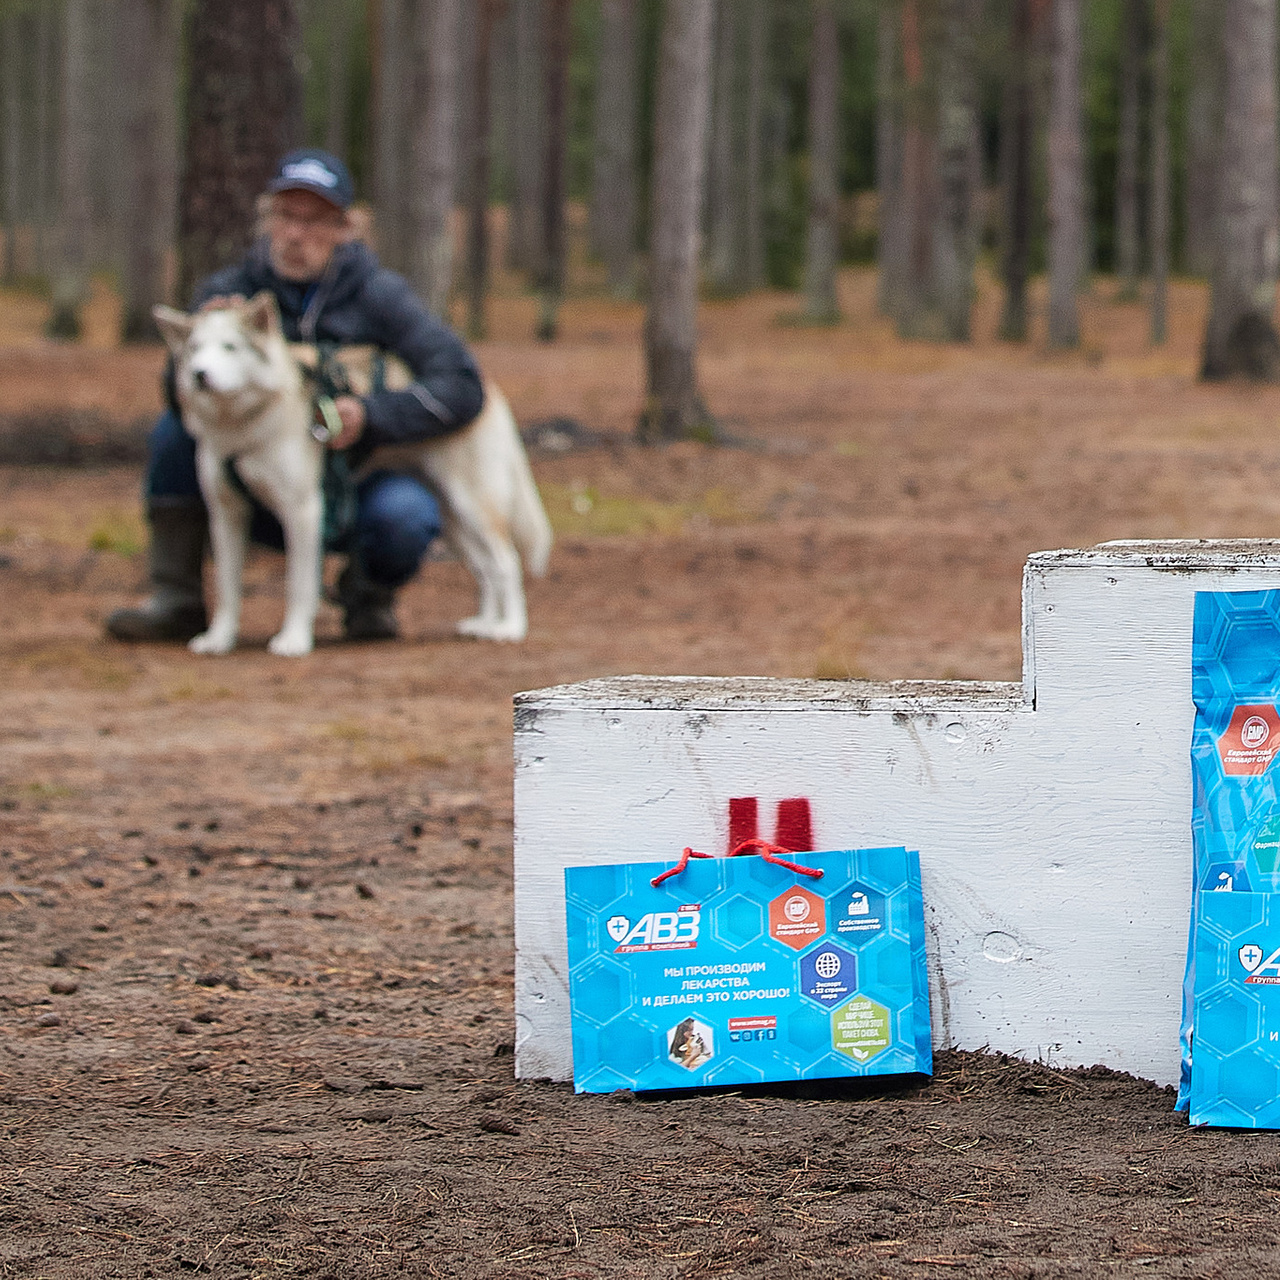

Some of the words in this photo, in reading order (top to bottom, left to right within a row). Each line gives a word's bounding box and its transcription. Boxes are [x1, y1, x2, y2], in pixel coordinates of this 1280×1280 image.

[619, 911, 700, 945] АВЗ
[664, 968, 683, 977] МЫ
[686, 962, 766, 976] ПРОИЗВОДИМ
[681, 977, 750, 990] ЛЕКАРСТВА
[642, 997, 652, 1006] И
[653, 994, 703, 1007] ДЕЛАЕМ
[706, 992, 730, 1002] ЭТО
[733, 988, 790, 1001] ХОРОШО!
[1269, 1032, 1278, 1041] И
